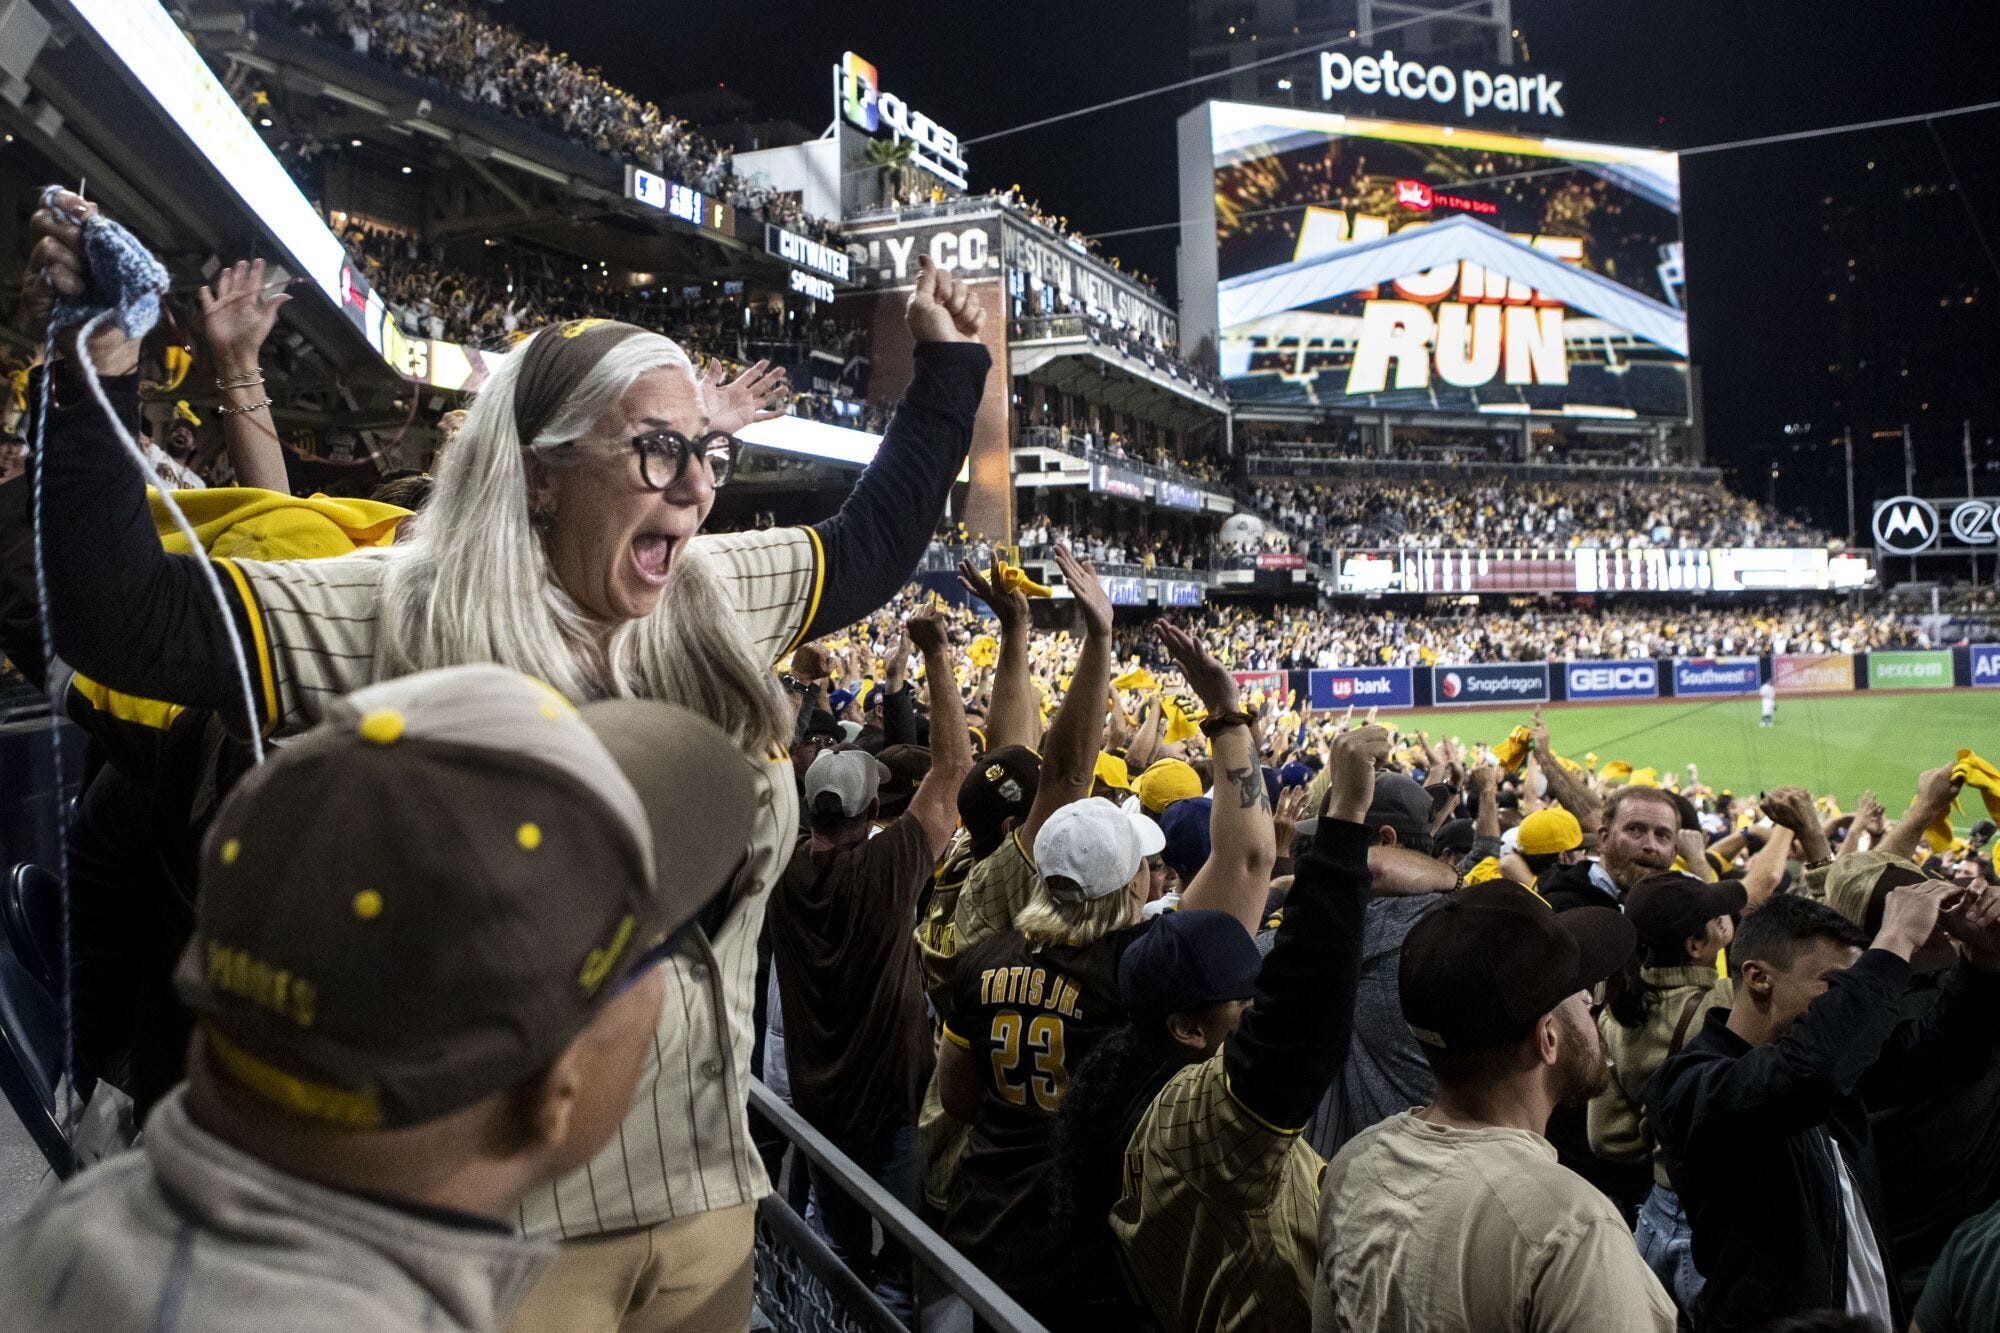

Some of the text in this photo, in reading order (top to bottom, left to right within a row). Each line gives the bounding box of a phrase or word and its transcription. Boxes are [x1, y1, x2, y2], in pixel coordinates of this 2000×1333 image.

[1320, 50, 1566, 118] petco park
[779, 228, 850, 281] CUTWATER
[1002, 224, 1072, 295] WESTERN
[790, 269, 835, 304] SPIRITS
[1345, 300, 1569, 395] RUN
[1332, 676, 1391, 694] us bank
[1466, 675, 1542, 692] Snapdragon
[1570, 667, 1656, 692] GEICO
[1679, 668, 1746, 686] Southwest
[981, 966, 1046, 1006] TATIS
[991, 1009, 1067, 1112] 23
